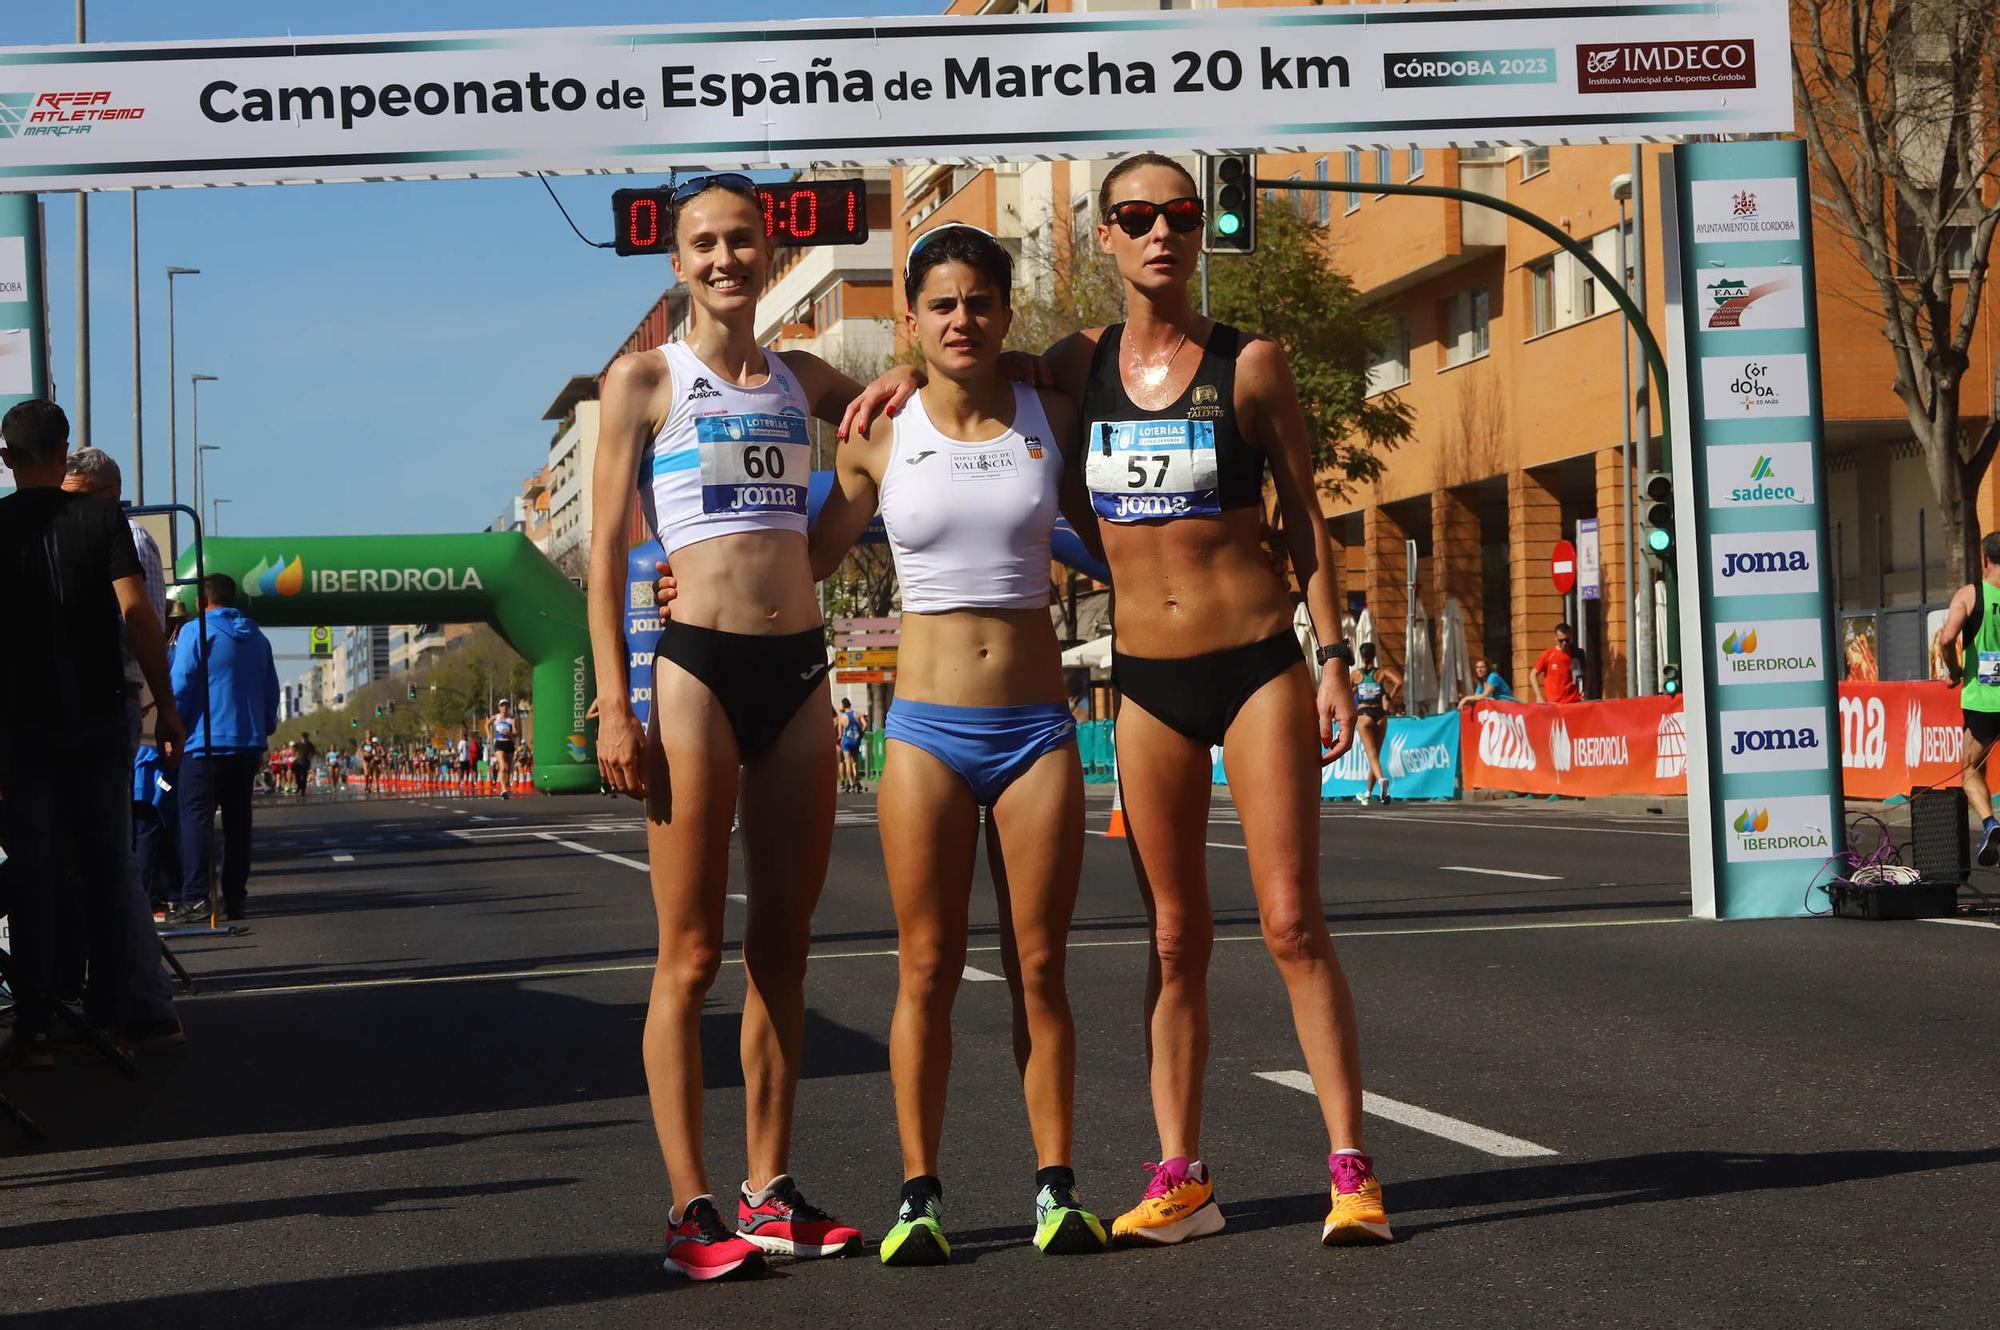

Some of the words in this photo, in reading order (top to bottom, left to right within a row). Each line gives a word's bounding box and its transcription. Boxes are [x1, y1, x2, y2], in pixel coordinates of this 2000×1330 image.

[1624, 44, 1747, 71] IMDECO
[1393, 58, 1497, 79] CÓRDOBA
[1499, 58, 1548, 75] 2023
[199, 71, 587, 129] Campeonato
[596, 79, 646, 110] de
[661, 57, 873, 117] España
[883, 71, 933, 103] de
[944, 53, 1159, 100] Marcha
[1171, 50, 1242, 93] 20
[1261, 47, 1349, 91] km
[1588, 76, 1621, 85] Instituto
[1622, 75, 1662, 86] Municipal
[1662, 75, 1674, 83] de
[1675, 73, 1711, 85] Deportes
[1712, 73, 1746, 82] Córdoba
[36, 91, 111, 110] RFEA
[30, 107, 145, 122] ATLETISMO
[24, 124, 92, 137] MARCHA
[1696, 221, 1749, 234] AYUNTAMIENTO
[1750, 222, 1759, 232] DE
[1760, 220, 1795, 232] CORDOBA
[1186, 409, 1225, 419] TALENTS
[746, 418, 789, 429] LOTERÍAS
[1140, 423, 1186, 436] LOTERÍAS
[743, 445, 785, 479] 60
[1127, 454, 1171, 489] 57
[1732, 483, 1795, 501] sadeco
[311, 567, 484, 593] IBERDROLA
[1732, 656, 1817, 672] IBERDROLA
[573, 655, 585, 732] IBERDROLA
[1573, 735, 1629, 767] IBERDROLA
[1743, 834, 1828, 851] IBERDROLA
